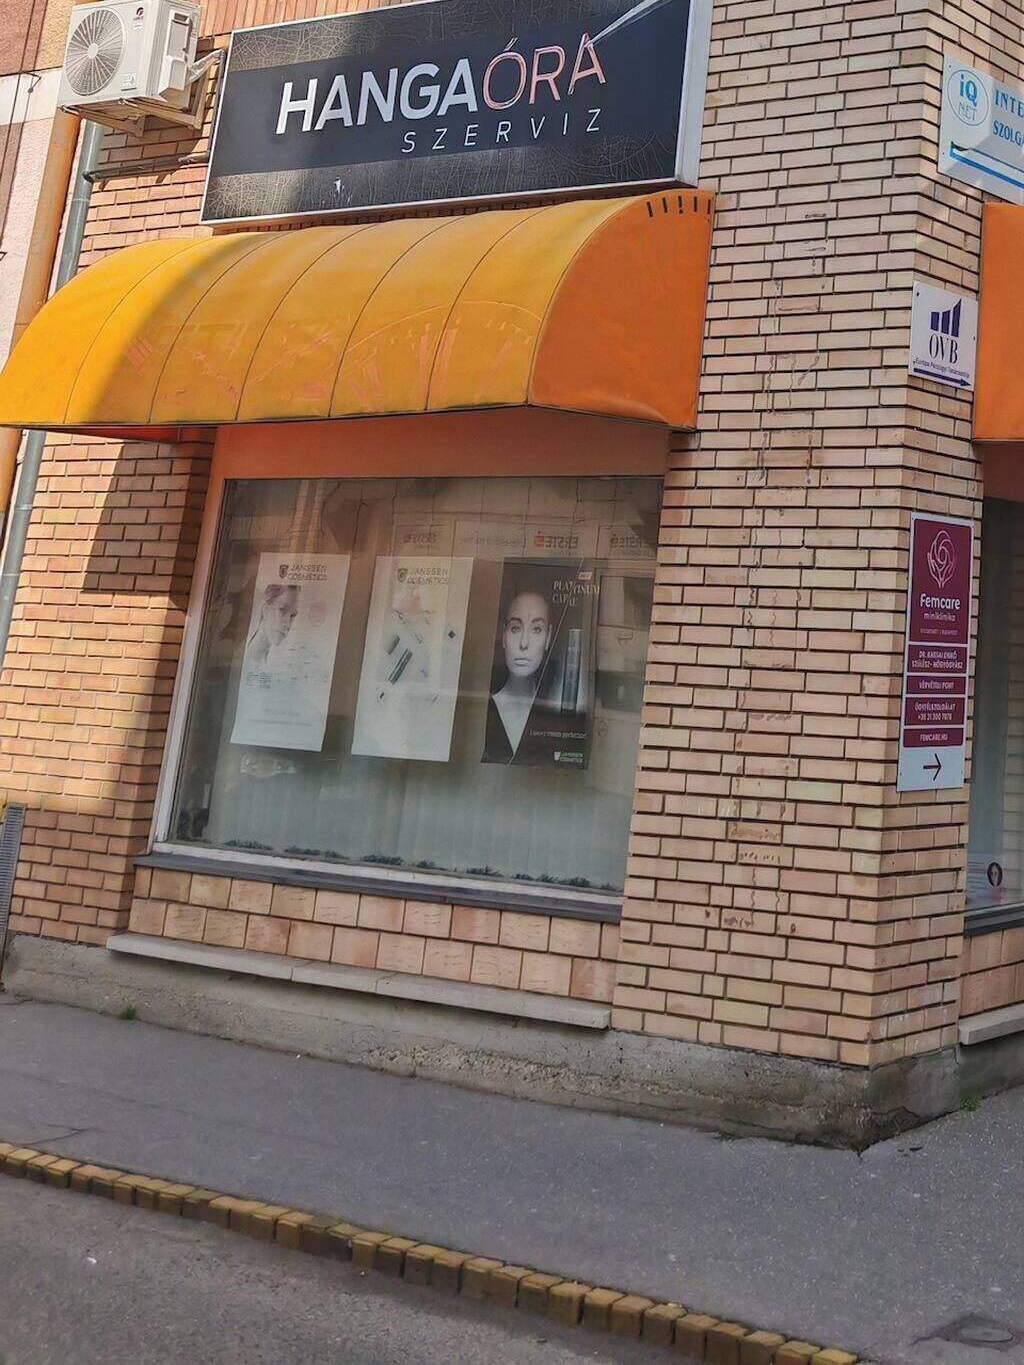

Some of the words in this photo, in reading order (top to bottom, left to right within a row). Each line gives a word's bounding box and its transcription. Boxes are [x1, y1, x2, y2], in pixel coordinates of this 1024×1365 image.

[275, 32, 606, 135] HANGAÓRA
[958, 102, 977, 122] NET
[401, 108, 602, 154] SZERVIZ
[929, 333, 959, 364] OVB
[920, 593, 961, 610] Femcare
